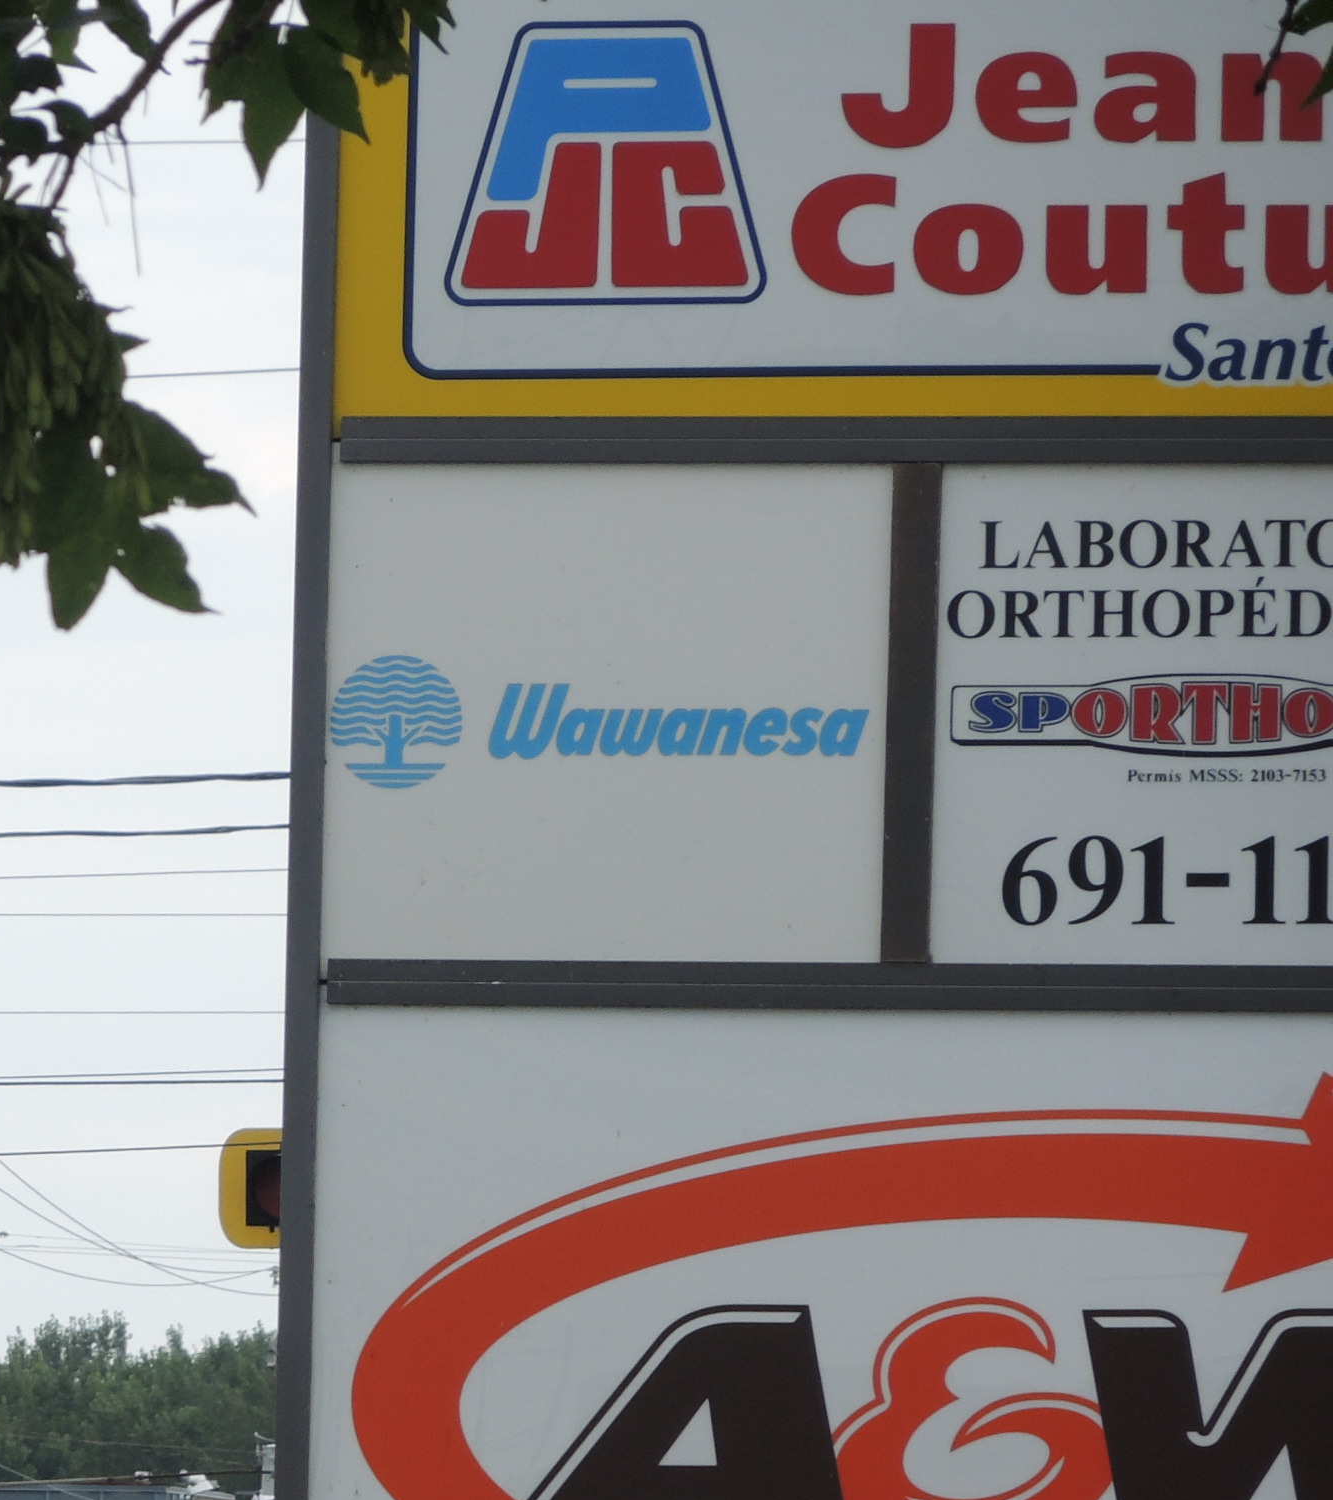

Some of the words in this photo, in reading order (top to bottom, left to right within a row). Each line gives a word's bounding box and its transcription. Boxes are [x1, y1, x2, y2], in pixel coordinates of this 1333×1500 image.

[841, 22, 1323, 149] Jean
[791, 173, 1333, 295] Coutu
[1164, 322, 1333, 382] Sant
[946, 576, 1332, 639] ORTHOPÉD
[488, 683, 870, 759] Wawanesa
[968, 681, 1333, 745] SPORTHO
[1127, 769, 1182, 783] Permis
[1189, 769, 1243, 783] MSSS:
[1250, 769, 1327, 783] 2103-7153
[1002, 835, 1333, 926] 691-11
